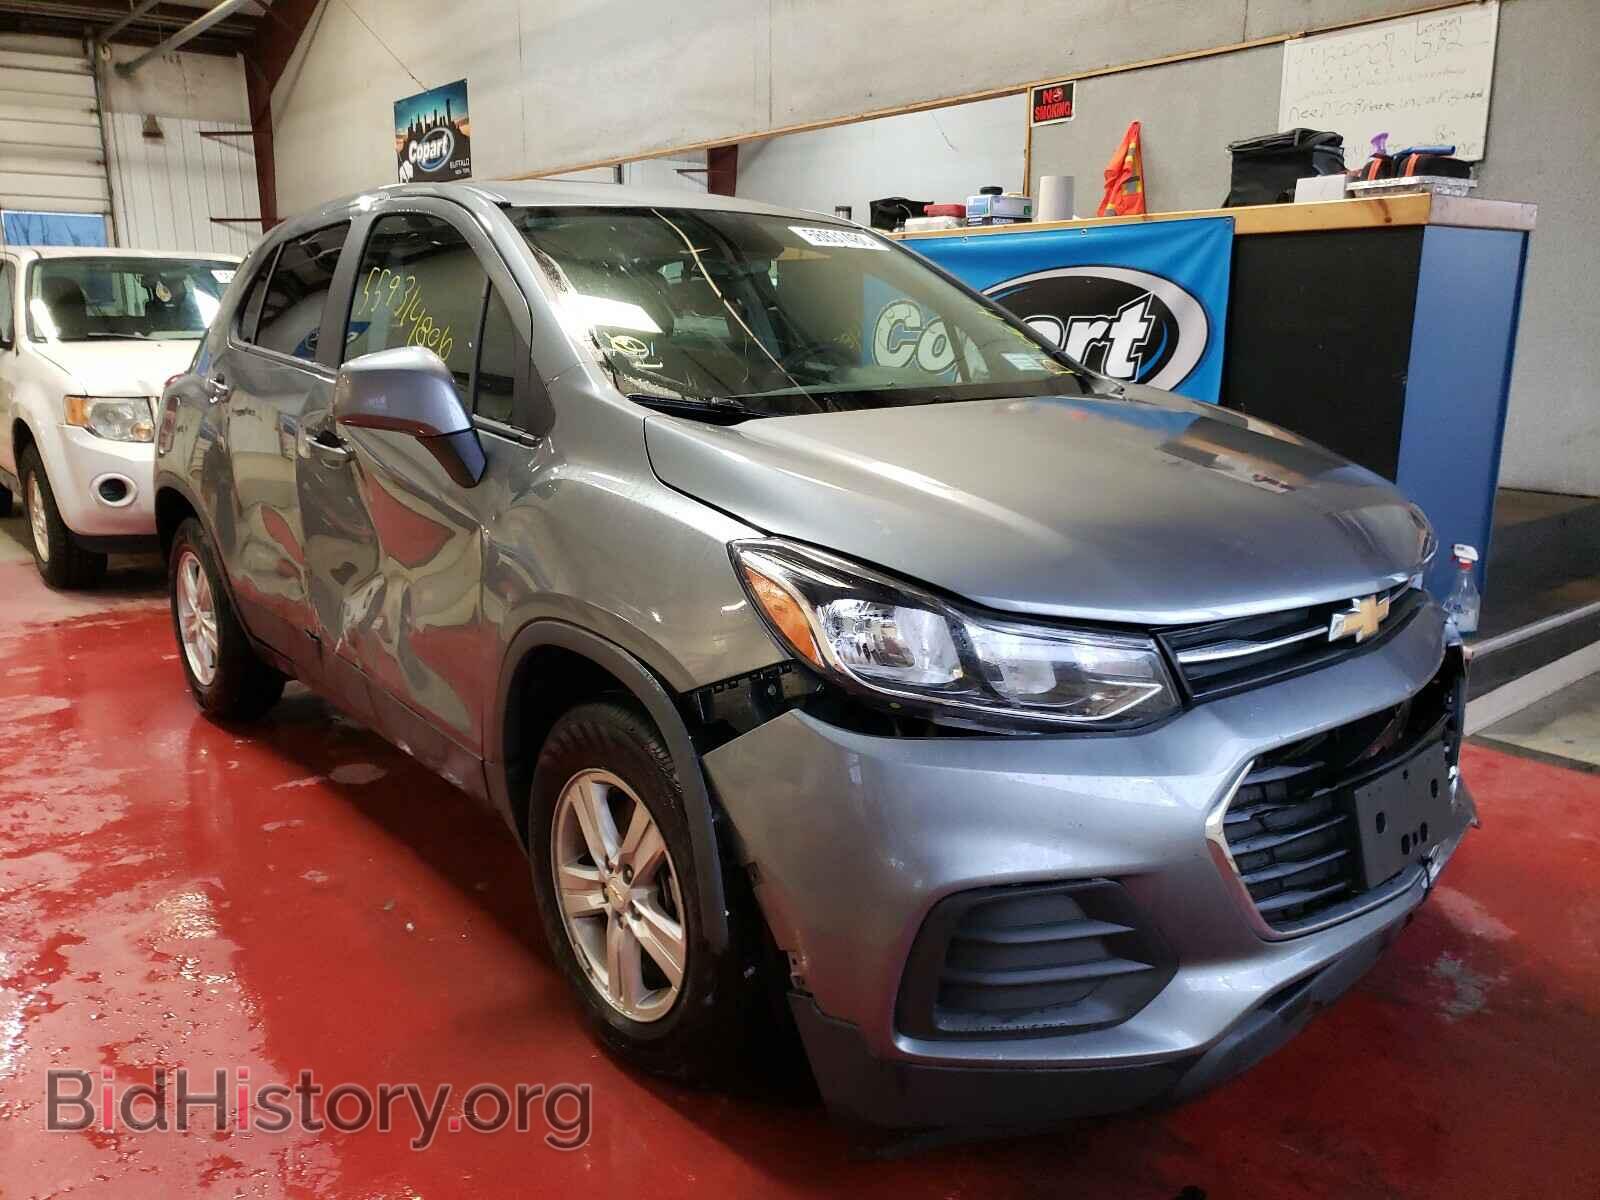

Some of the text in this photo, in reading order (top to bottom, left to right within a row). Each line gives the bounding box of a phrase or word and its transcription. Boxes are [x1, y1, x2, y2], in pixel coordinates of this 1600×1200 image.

[1043, 87, 1063, 104] NO
[1034, 101, 1071, 120] SMOKING
[408, 132, 449, 166] Copart
